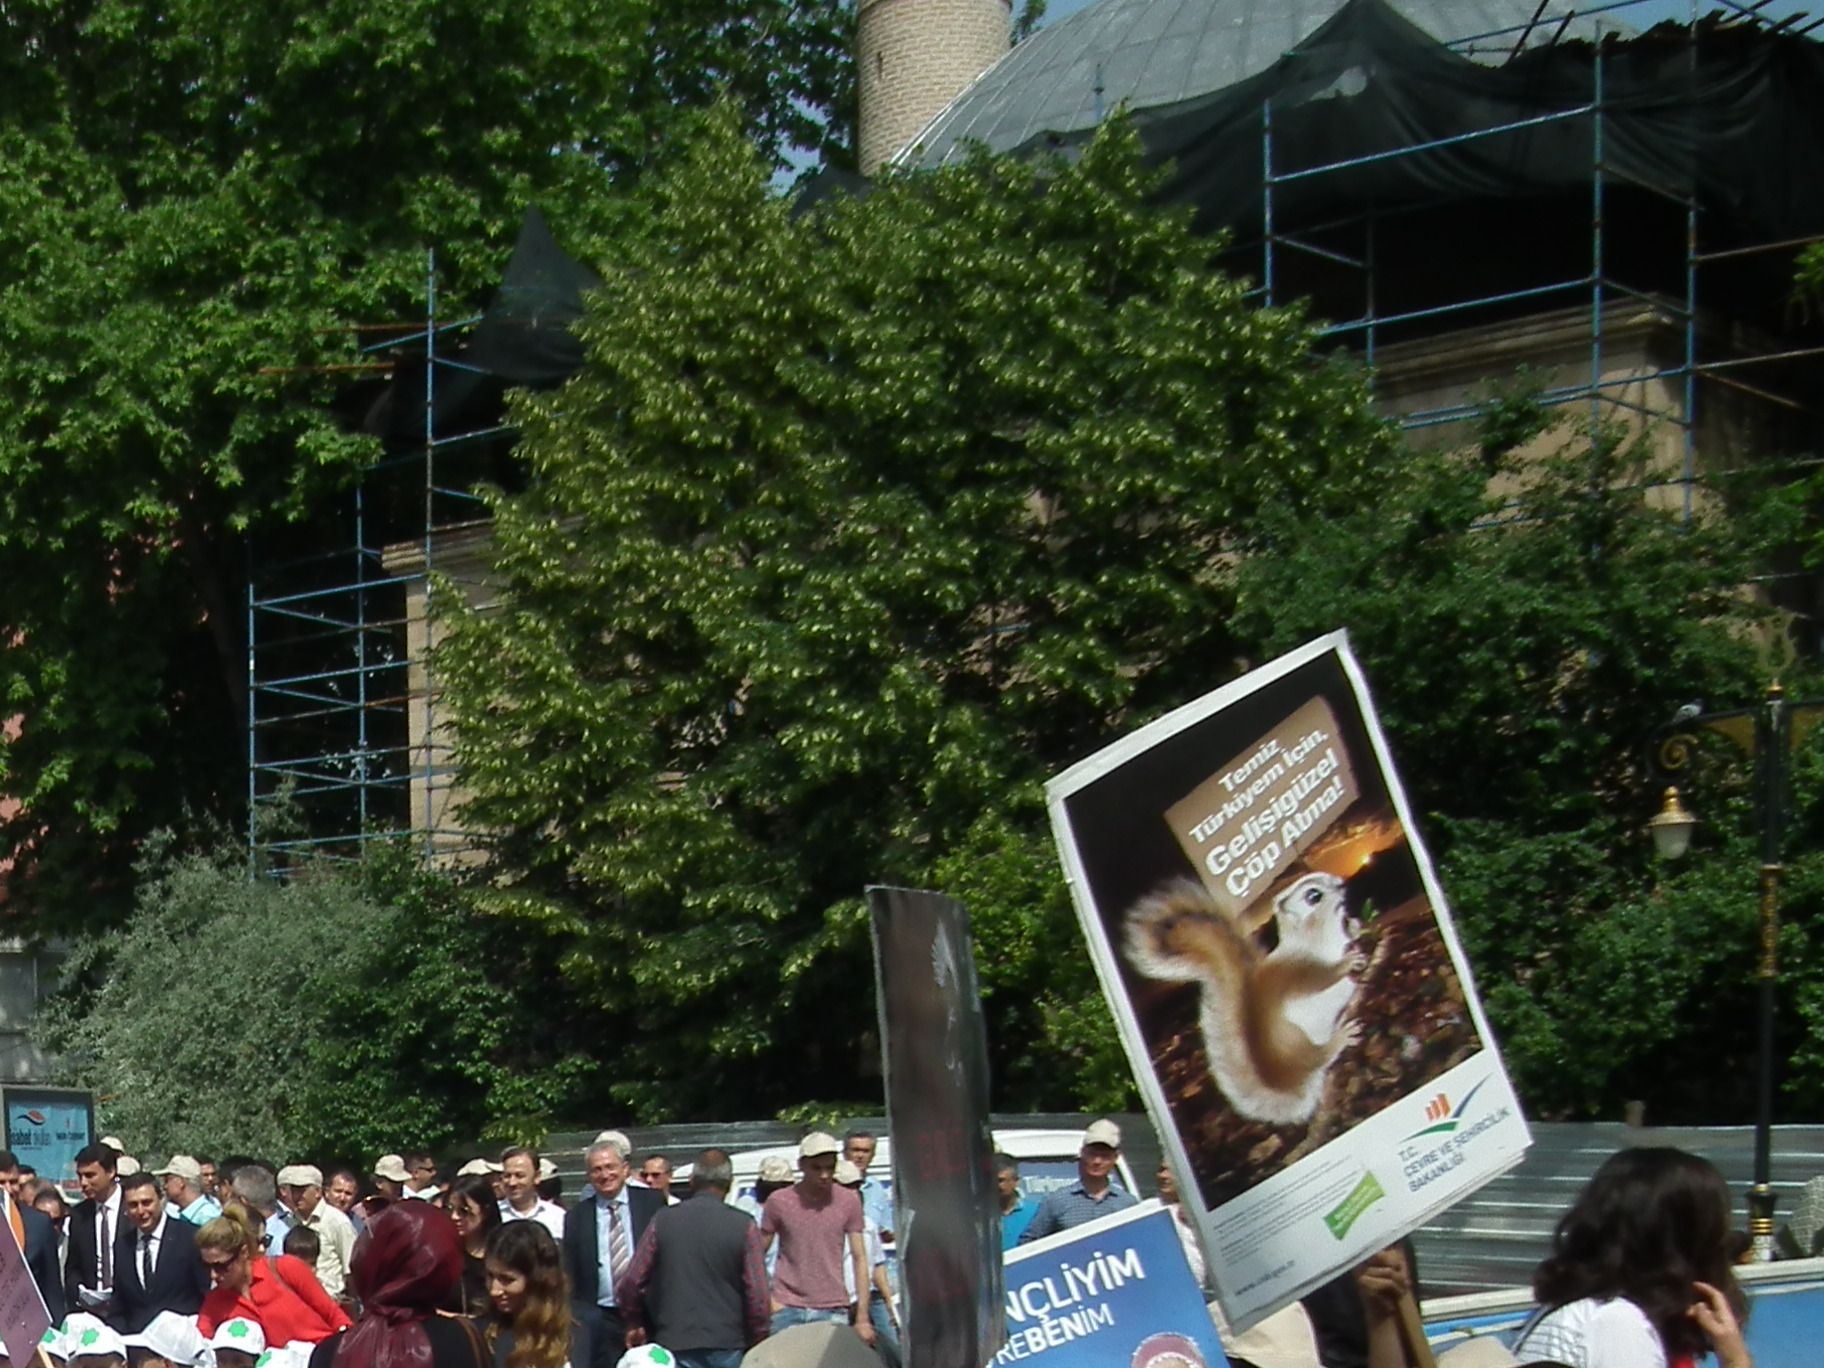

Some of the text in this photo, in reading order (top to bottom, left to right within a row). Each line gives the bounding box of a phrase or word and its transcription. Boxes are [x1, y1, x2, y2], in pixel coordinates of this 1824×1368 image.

[1188, 763, 1284, 843] Türkiyem
[1218, 739, 1280, 792] Temiz
[1204, 748, 1339, 876] Gelişigüzel
[1226, 775, 1345, 897] Çöp Atma!
[1440, 1141, 1454, 1157] VE
[1005, 1248, 1146, 1324] NÇLİYİM
